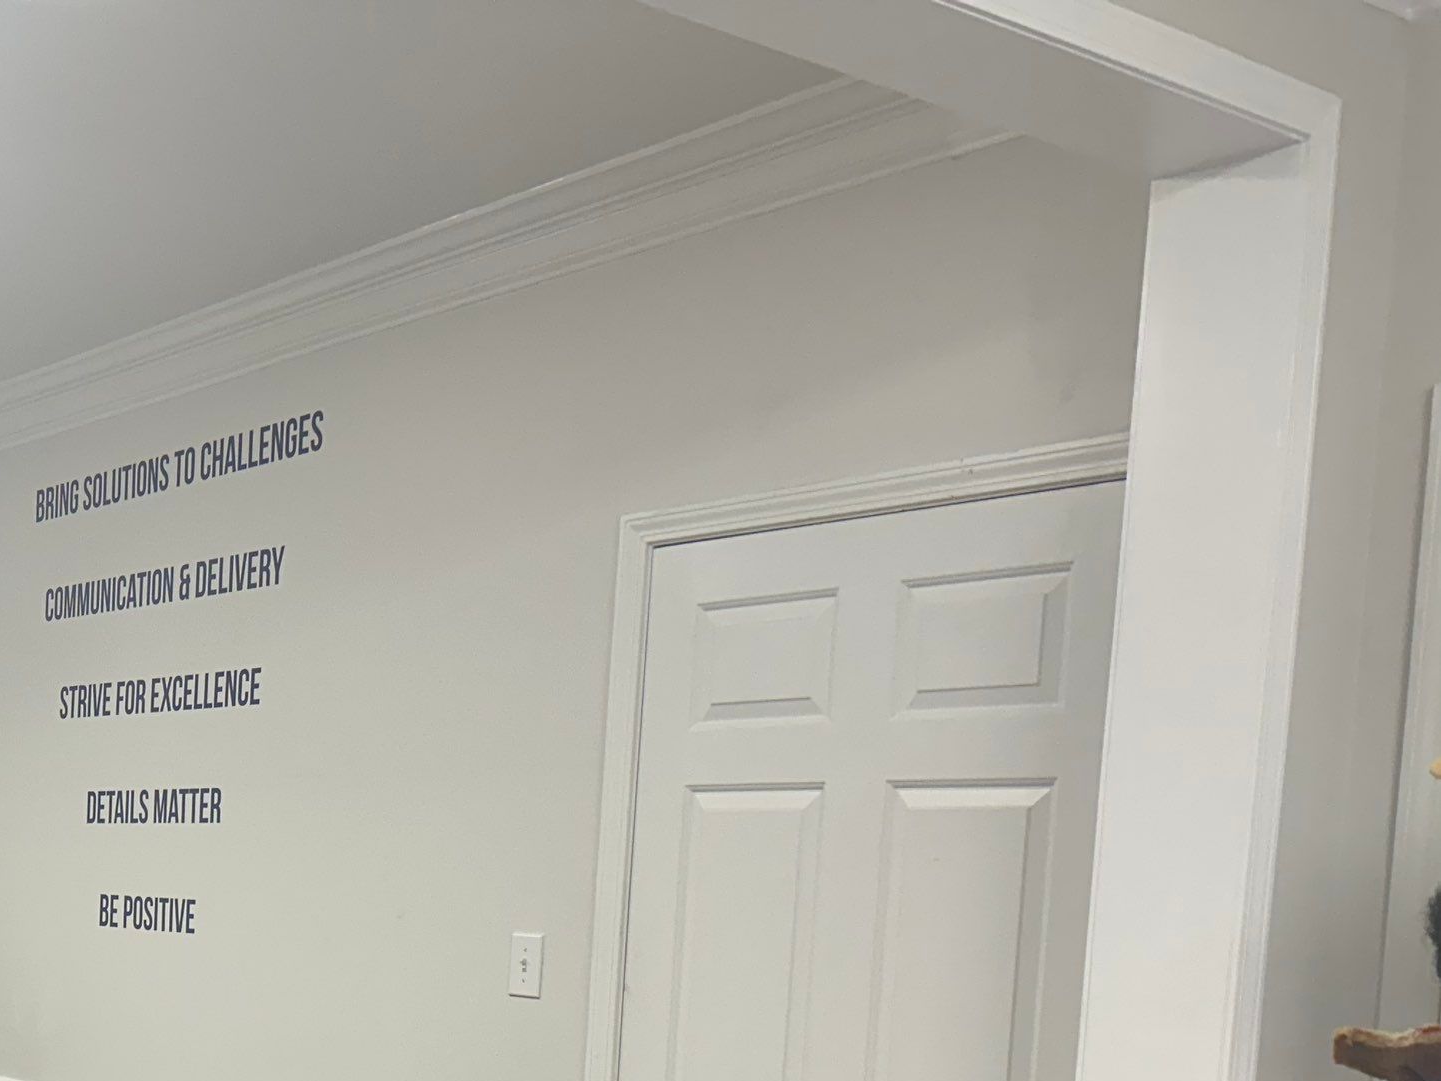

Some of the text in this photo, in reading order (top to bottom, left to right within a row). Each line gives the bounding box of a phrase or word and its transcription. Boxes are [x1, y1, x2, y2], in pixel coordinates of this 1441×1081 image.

[35, 410, 324, 523] BRING SOLUTIONS TO CHALLENGES
[45, 545, 285, 622] COMMUNICATION & DELIVERY
[59, 667, 262, 719] STRIVE FOR EXCELLENCE
[86, 787, 222, 824] DETAILS MATTER
[99, 893, 196, 934] BE POSITIVE
